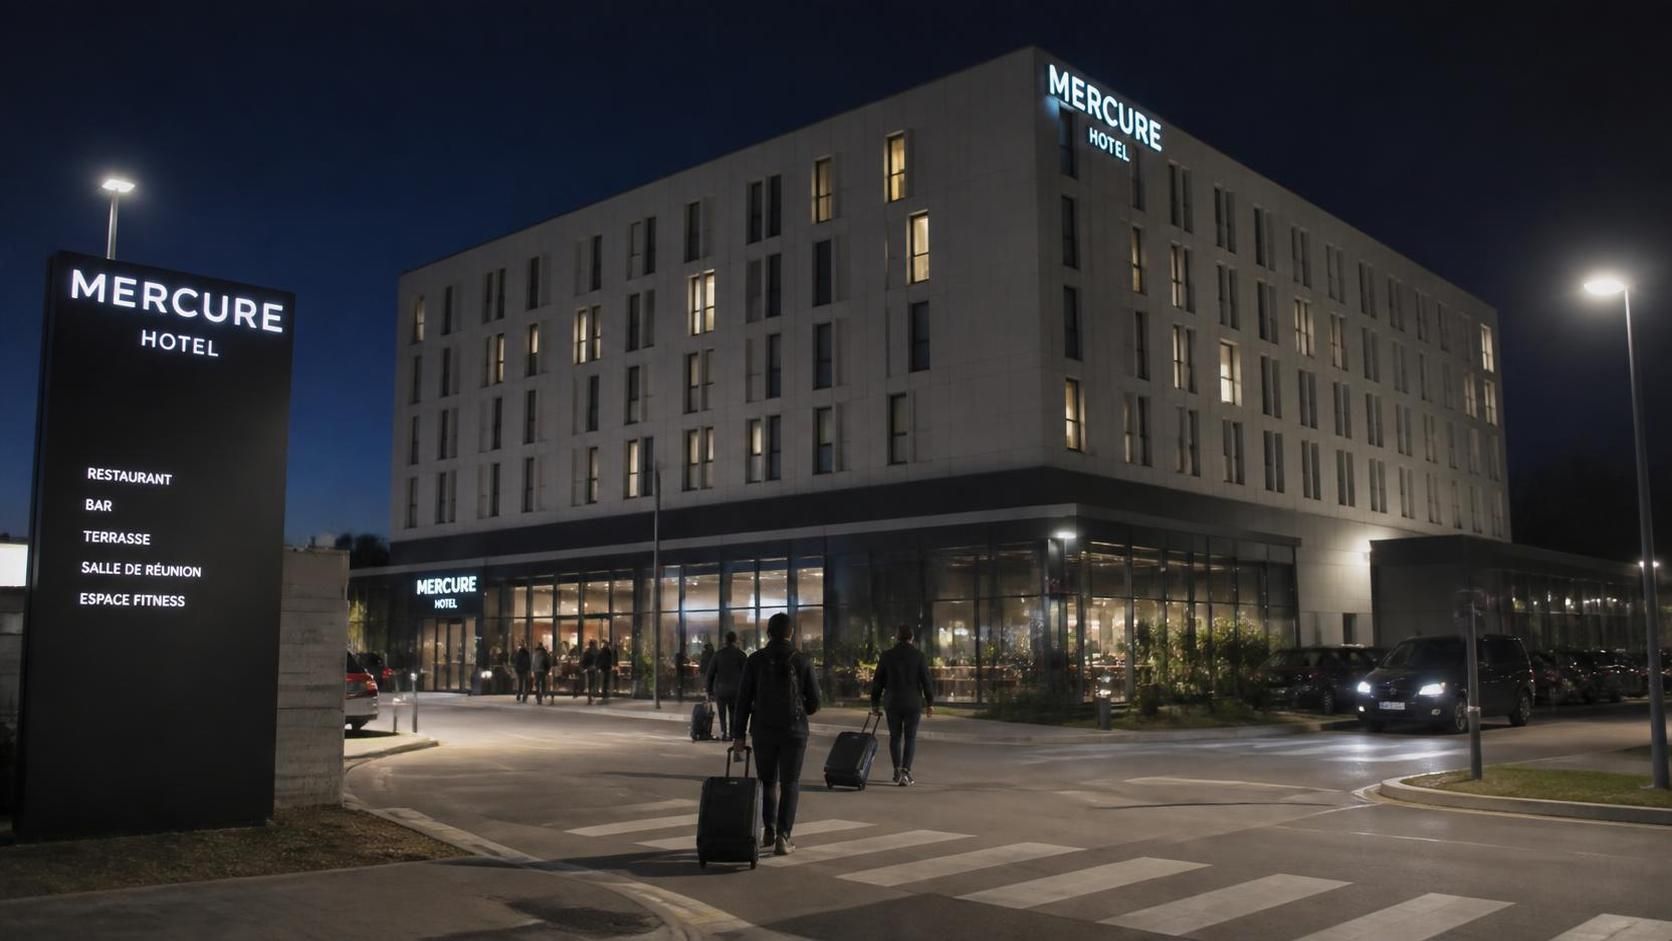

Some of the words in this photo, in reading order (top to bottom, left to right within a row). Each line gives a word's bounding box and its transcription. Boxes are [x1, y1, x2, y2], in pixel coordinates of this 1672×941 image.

[1049, 64, 1162, 152] MERCURE
[1089, 127, 1130, 162] HOTEL
[71, 268, 284, 334] MERCURE
[141, 329, 219, 357] HOTEL
[87, 467, 172, 485] RESTAURANT
[85, 498, 113, 512] BAR
[83, 530, 151, 546] TERRASSE
[81, 561, 121, 575] SALLE
[125, 563, 142, 575] DE
[145, 562, 202, 578] RÉUNION
[416, 575, 477, 595] MERCURE
[79, 592, 130, 606] ESPACE
[133, 594, 186, 608] FITNESS
[434, 598, 458, 609] HOTEL
